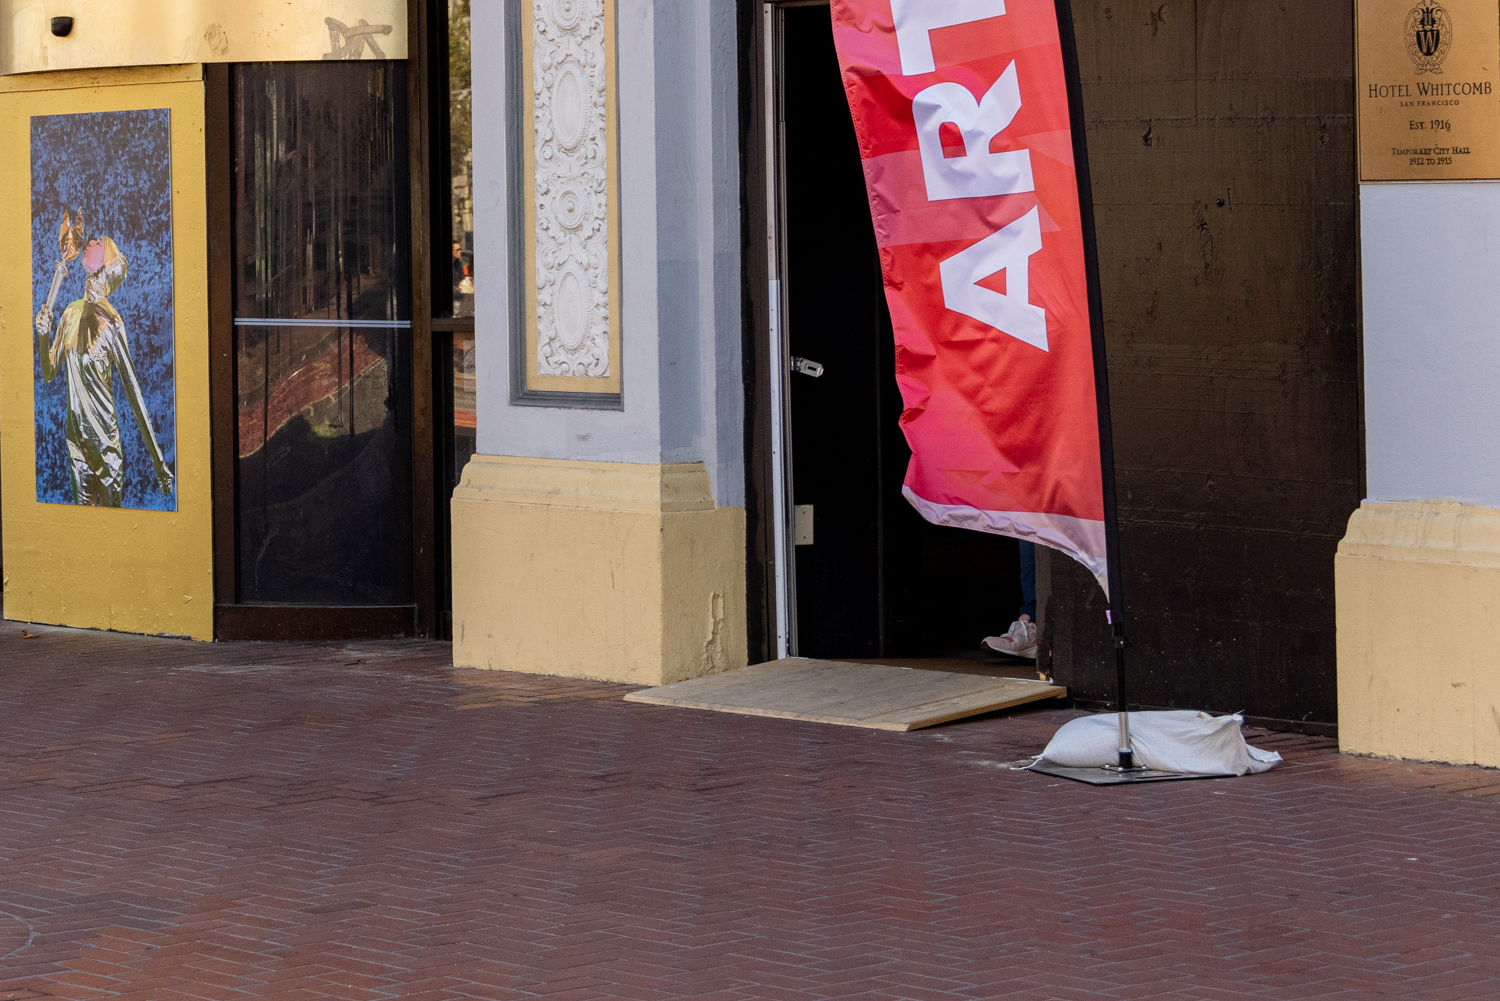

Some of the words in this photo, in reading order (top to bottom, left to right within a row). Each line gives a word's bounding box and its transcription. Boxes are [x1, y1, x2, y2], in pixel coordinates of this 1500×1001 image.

[1367, 83, 1413, 99] HOTEL
[1416, 81, 1493, 98] WHITCOMB
[1417, 99, 1460, 107] FRANCISCO
[1409, 119, 1428, 131] EST.
[1430, 119, 1451, 131] 1916
[1391, 147, 1432, 156] TEMPORARY
[1433, 146, 1451, 156] CITY
[1452, 146, 1471, 155] HALL
